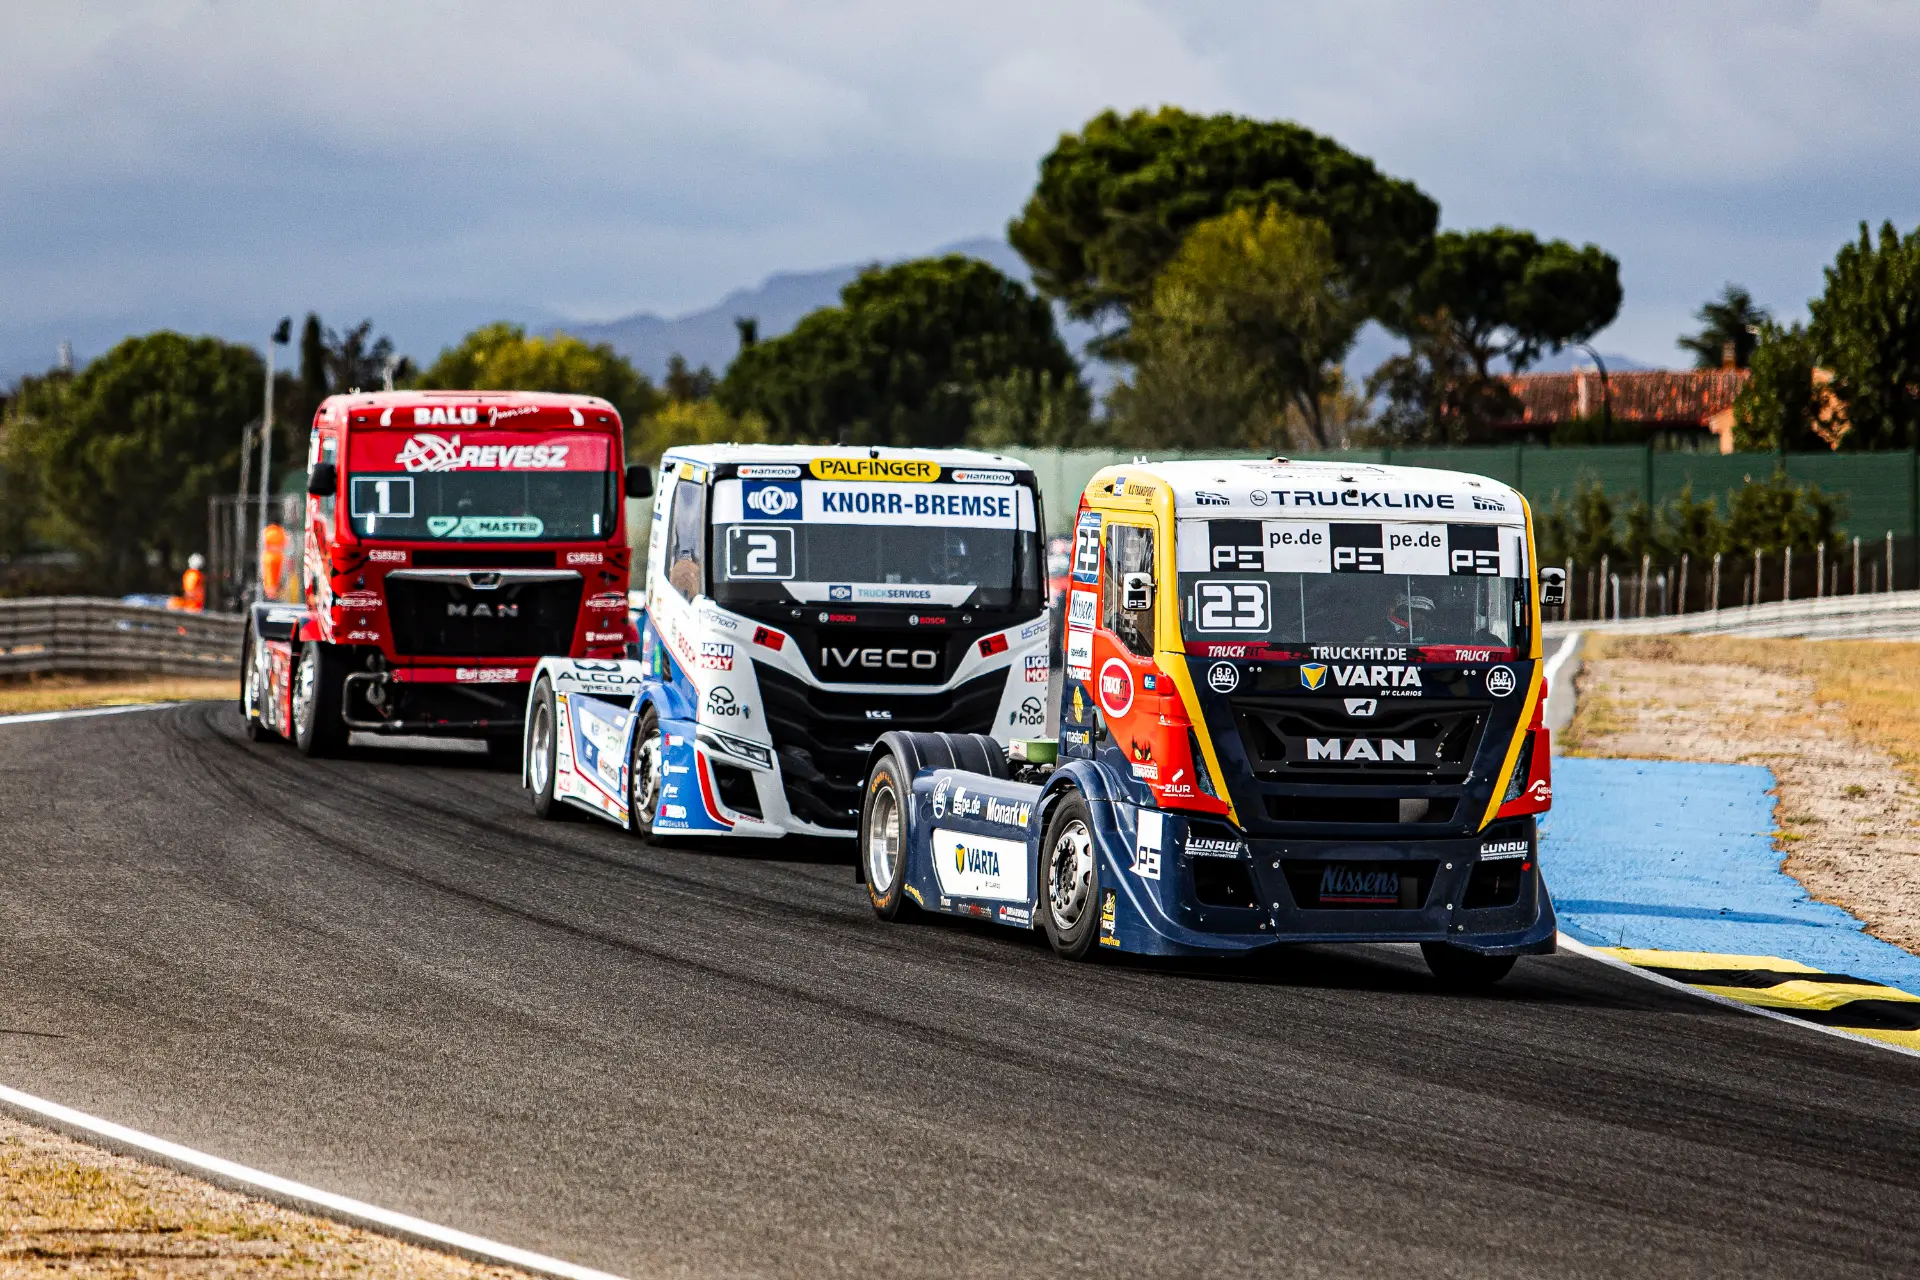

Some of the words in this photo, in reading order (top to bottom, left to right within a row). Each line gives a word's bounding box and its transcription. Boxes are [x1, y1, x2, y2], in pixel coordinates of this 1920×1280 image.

[413, 407, 478, 425] BALU
[460, 445, 569, 468] REVESZ
[821, 460, 931, 477] PALFINGER
[375, 481, 390, 514] 1
[822, 491, 1011, 518] KNORR-BREMSE
[1271, 490, 1455, 509] TRUCKLINE
[480, 522, 537, 531] MASTER
[1270, 529, 1323, 548] pe.de
[1390, 531, 1441, 550] pe.de
[747, 534, 777, 573] 2
[1213, 545, 1264, 569] PE
[1334, 546, 1384, 571] PE
[1451, 549, 1500, 574] PE
[858, 588, 931, 599] TRUCKSERVICES
[447, 603, 519, 617] MAN
[1202, 585, 1265, 628] 23
[829, 614, 856, 623] BOSCH
[920, 616, 946, 625] BOSCH
[822, 647, 937, 669] IVECO
[1026, 656, 1049, 669] LIQU
[1311, 646, 1407, 661] TRUCKFIT.DE
[558, 671, 642, 685] ALCOA
[1332, 665, 1422, 687] VARTA
[707, 702, 740, 716] hadi
[1307, 738, 1416, 761] MAN
[1165, 784, 1191, 793] ZIUR
[961, 796, 981, 818] pe.de
[986, 796, 1019, 826] Monark
[1185, 838, 1236, 852] LUNAU
[1481, 841, 1525, 854] LUNAU
[967, 847, 1000, 877] VARTA
[1320, 864, 1399, 894] Nissens
